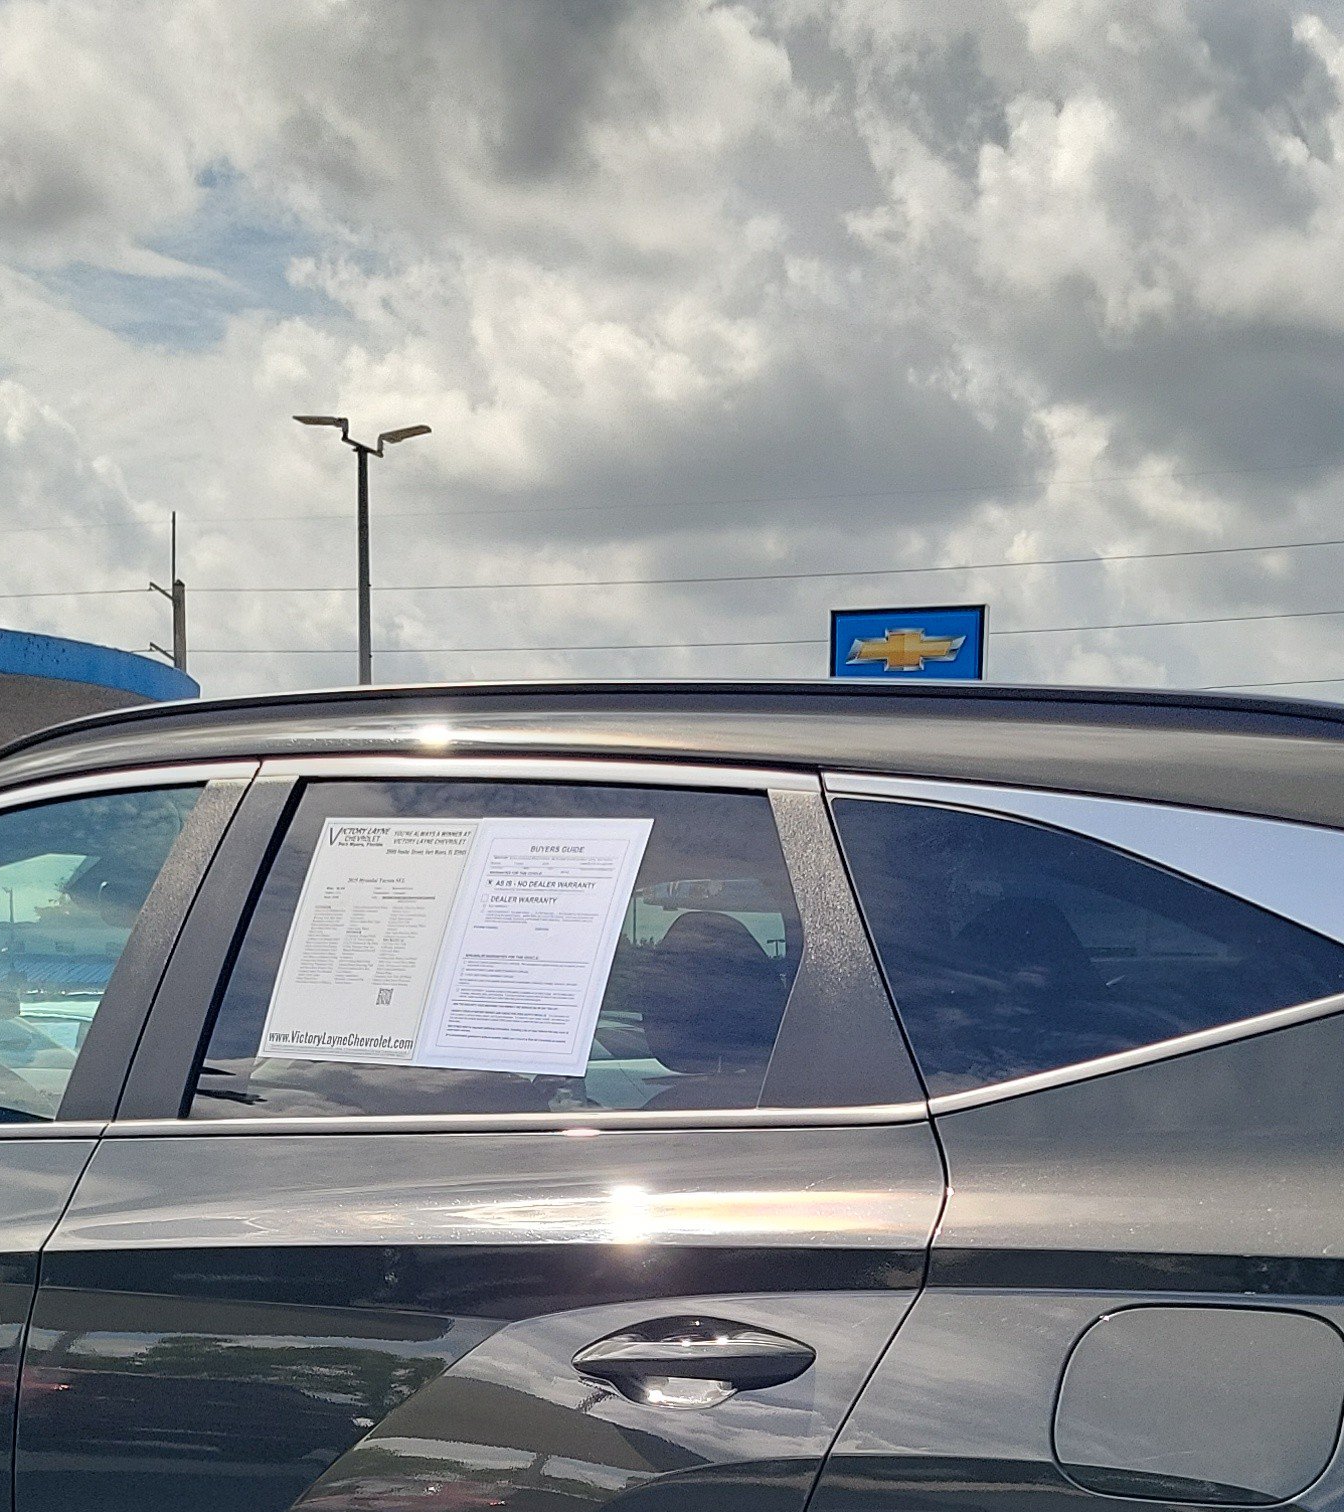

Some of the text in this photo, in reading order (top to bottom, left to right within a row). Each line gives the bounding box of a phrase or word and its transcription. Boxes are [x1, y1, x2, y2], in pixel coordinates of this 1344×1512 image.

[530, 845, 560, 853] BUYERS
[490, 895, 557, 904] DEALER WARRANTY
[268, 1030, 414, 1050] www.VictoryLayneChevrolet.com
